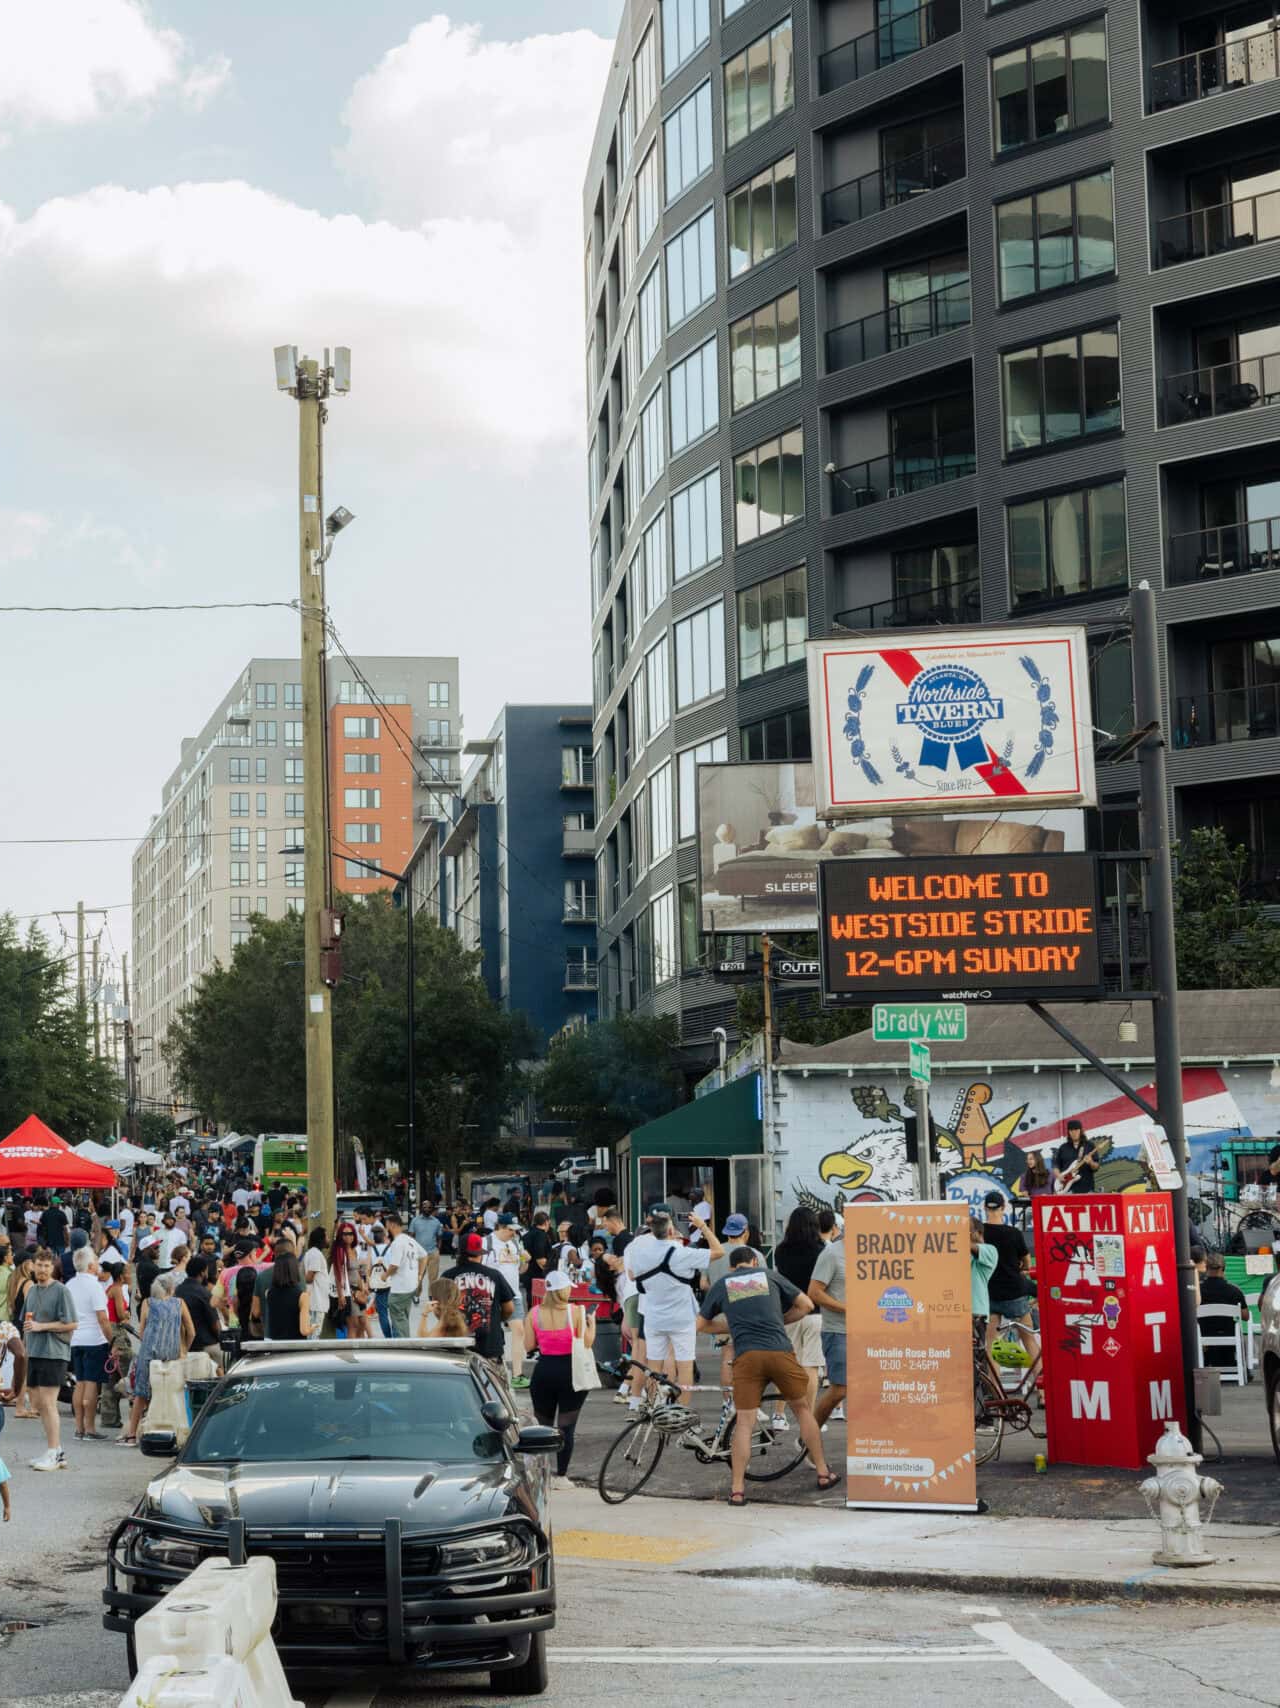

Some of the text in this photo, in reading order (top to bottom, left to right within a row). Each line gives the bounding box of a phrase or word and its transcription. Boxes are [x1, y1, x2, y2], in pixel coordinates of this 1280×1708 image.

[911, 681, 987, 703] Northside
[899, 700, 1001, 722] TAVERN
[933, 720, 968, 729] BLUES
[868, 871, 1049, 902] WELCOME TO
[830, 907, 1093, 941] WESTSIDE STRIDE
[845, 945, 1081, 977] 12-6PM SUNDAY
[942, 990, 979, 999] watchfire
[876, 1008, 963, 1038] Brady AVE
[938, 1023, 960, 1035] NW
[1047, 1206, 1114, 1232] ATM
[1130, 1205, 1168, 1232] ATM
[856, 1232, 958, 1255] BRADY AVE
[856, 1259, 915, 1281] STAGE
[455, 1271, 496, 1299] ENOM
[916, 1301, 925, 1313] &
[928, 1303, 969, 1313] NOVEL
[905, 1347, 927, 1358] Rose
[928, 1347, 951, 1358] Band
[880, 1359, 901, 1370] 12:00
[909, 1359, 939, 1370] 2:45PM
[883, 1380, 915, 1391] Divided
[917, 1381, 928, 1394] by
[866, 1462, 925, 1473] #WestsideStride
